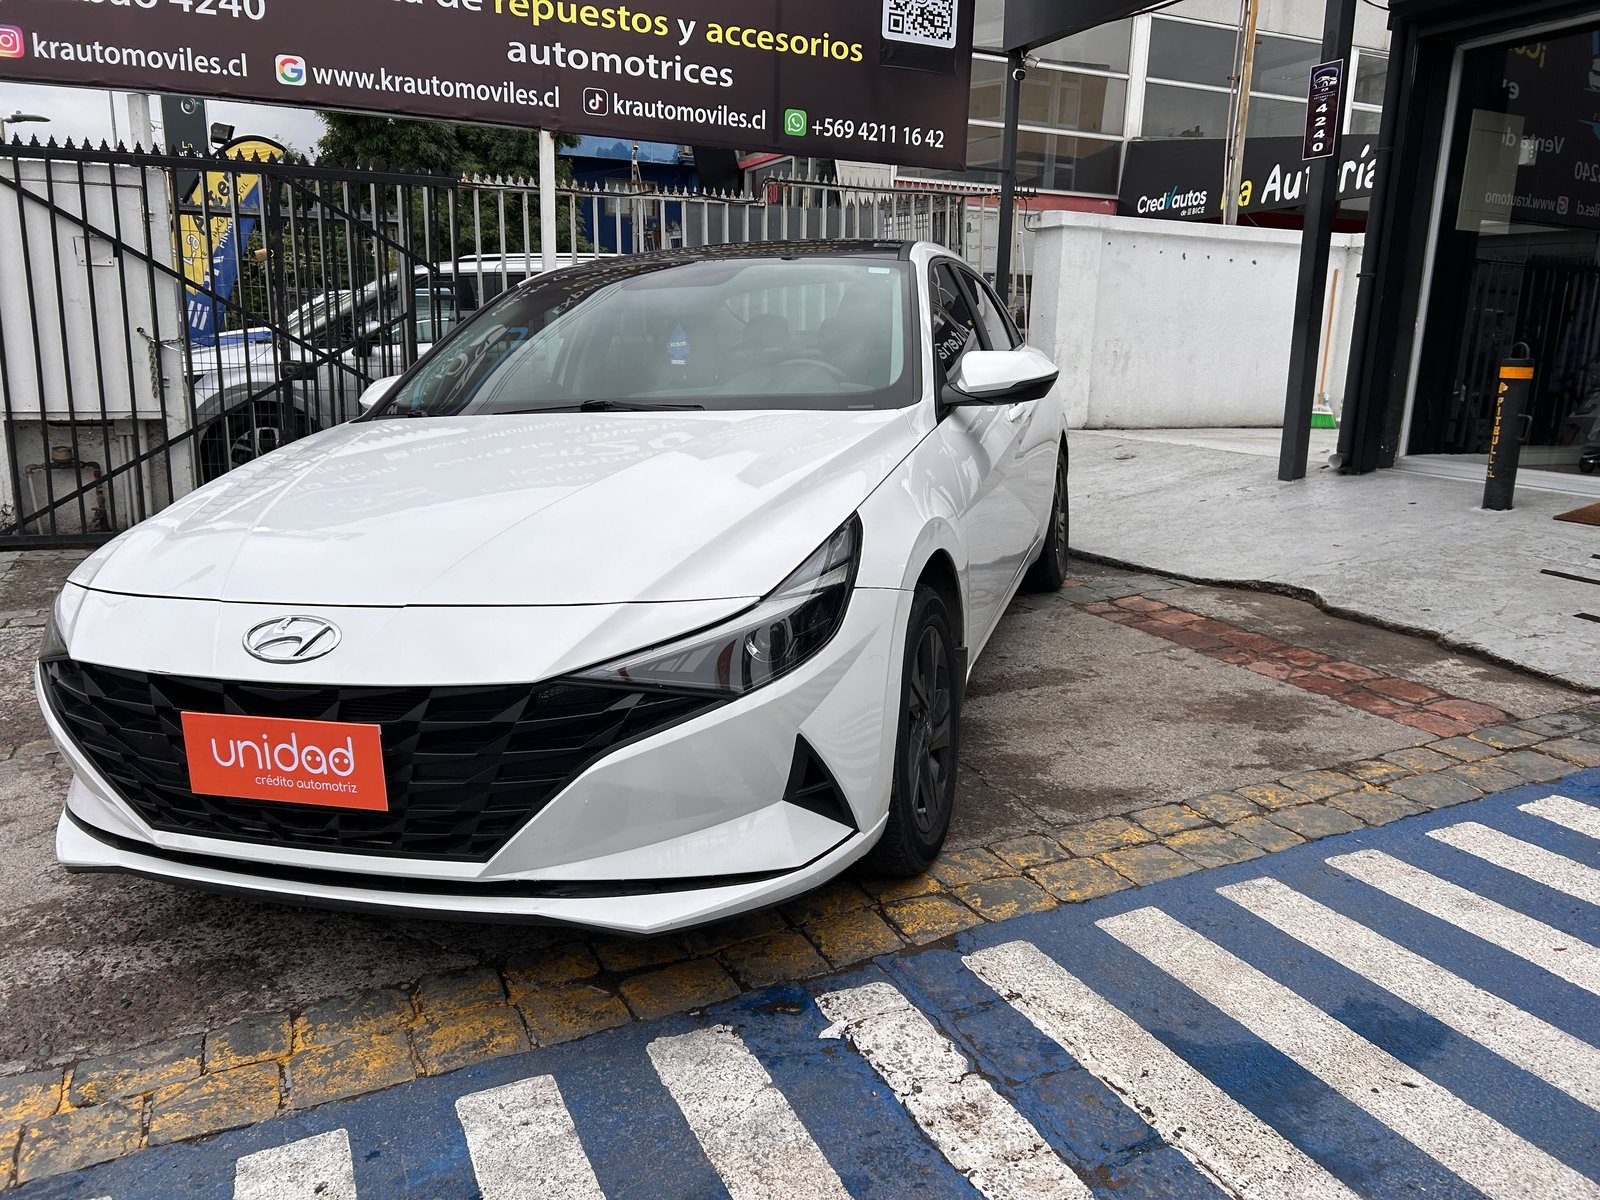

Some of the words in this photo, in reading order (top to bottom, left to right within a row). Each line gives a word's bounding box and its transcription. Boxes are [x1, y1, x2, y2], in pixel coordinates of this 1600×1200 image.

[494, 0, 670, 37] repuestos
[676, 18, 697, 46] y
[706, 20, 864, 63] accesorios
[32, 32, 248, 78] krautomoviles.cl
[506, 40, 734, 88] automotrices
[311, 66, 560, 109] www.krautomoviles.cl
[613, 93, 767, 131] krautomoviles.cl
[811, 117, 855, 139] +569
[858, 121, 897, 144] 4211
[903, 126, 922, 146] 16
[924, 129, 945, 149] 42
[1260, 143, 1377, 205] Auría
[211, 732, 355, 777] unidad
[255, 774, 294, 788] crédito
[296, 779, 358, 794] automotriz
